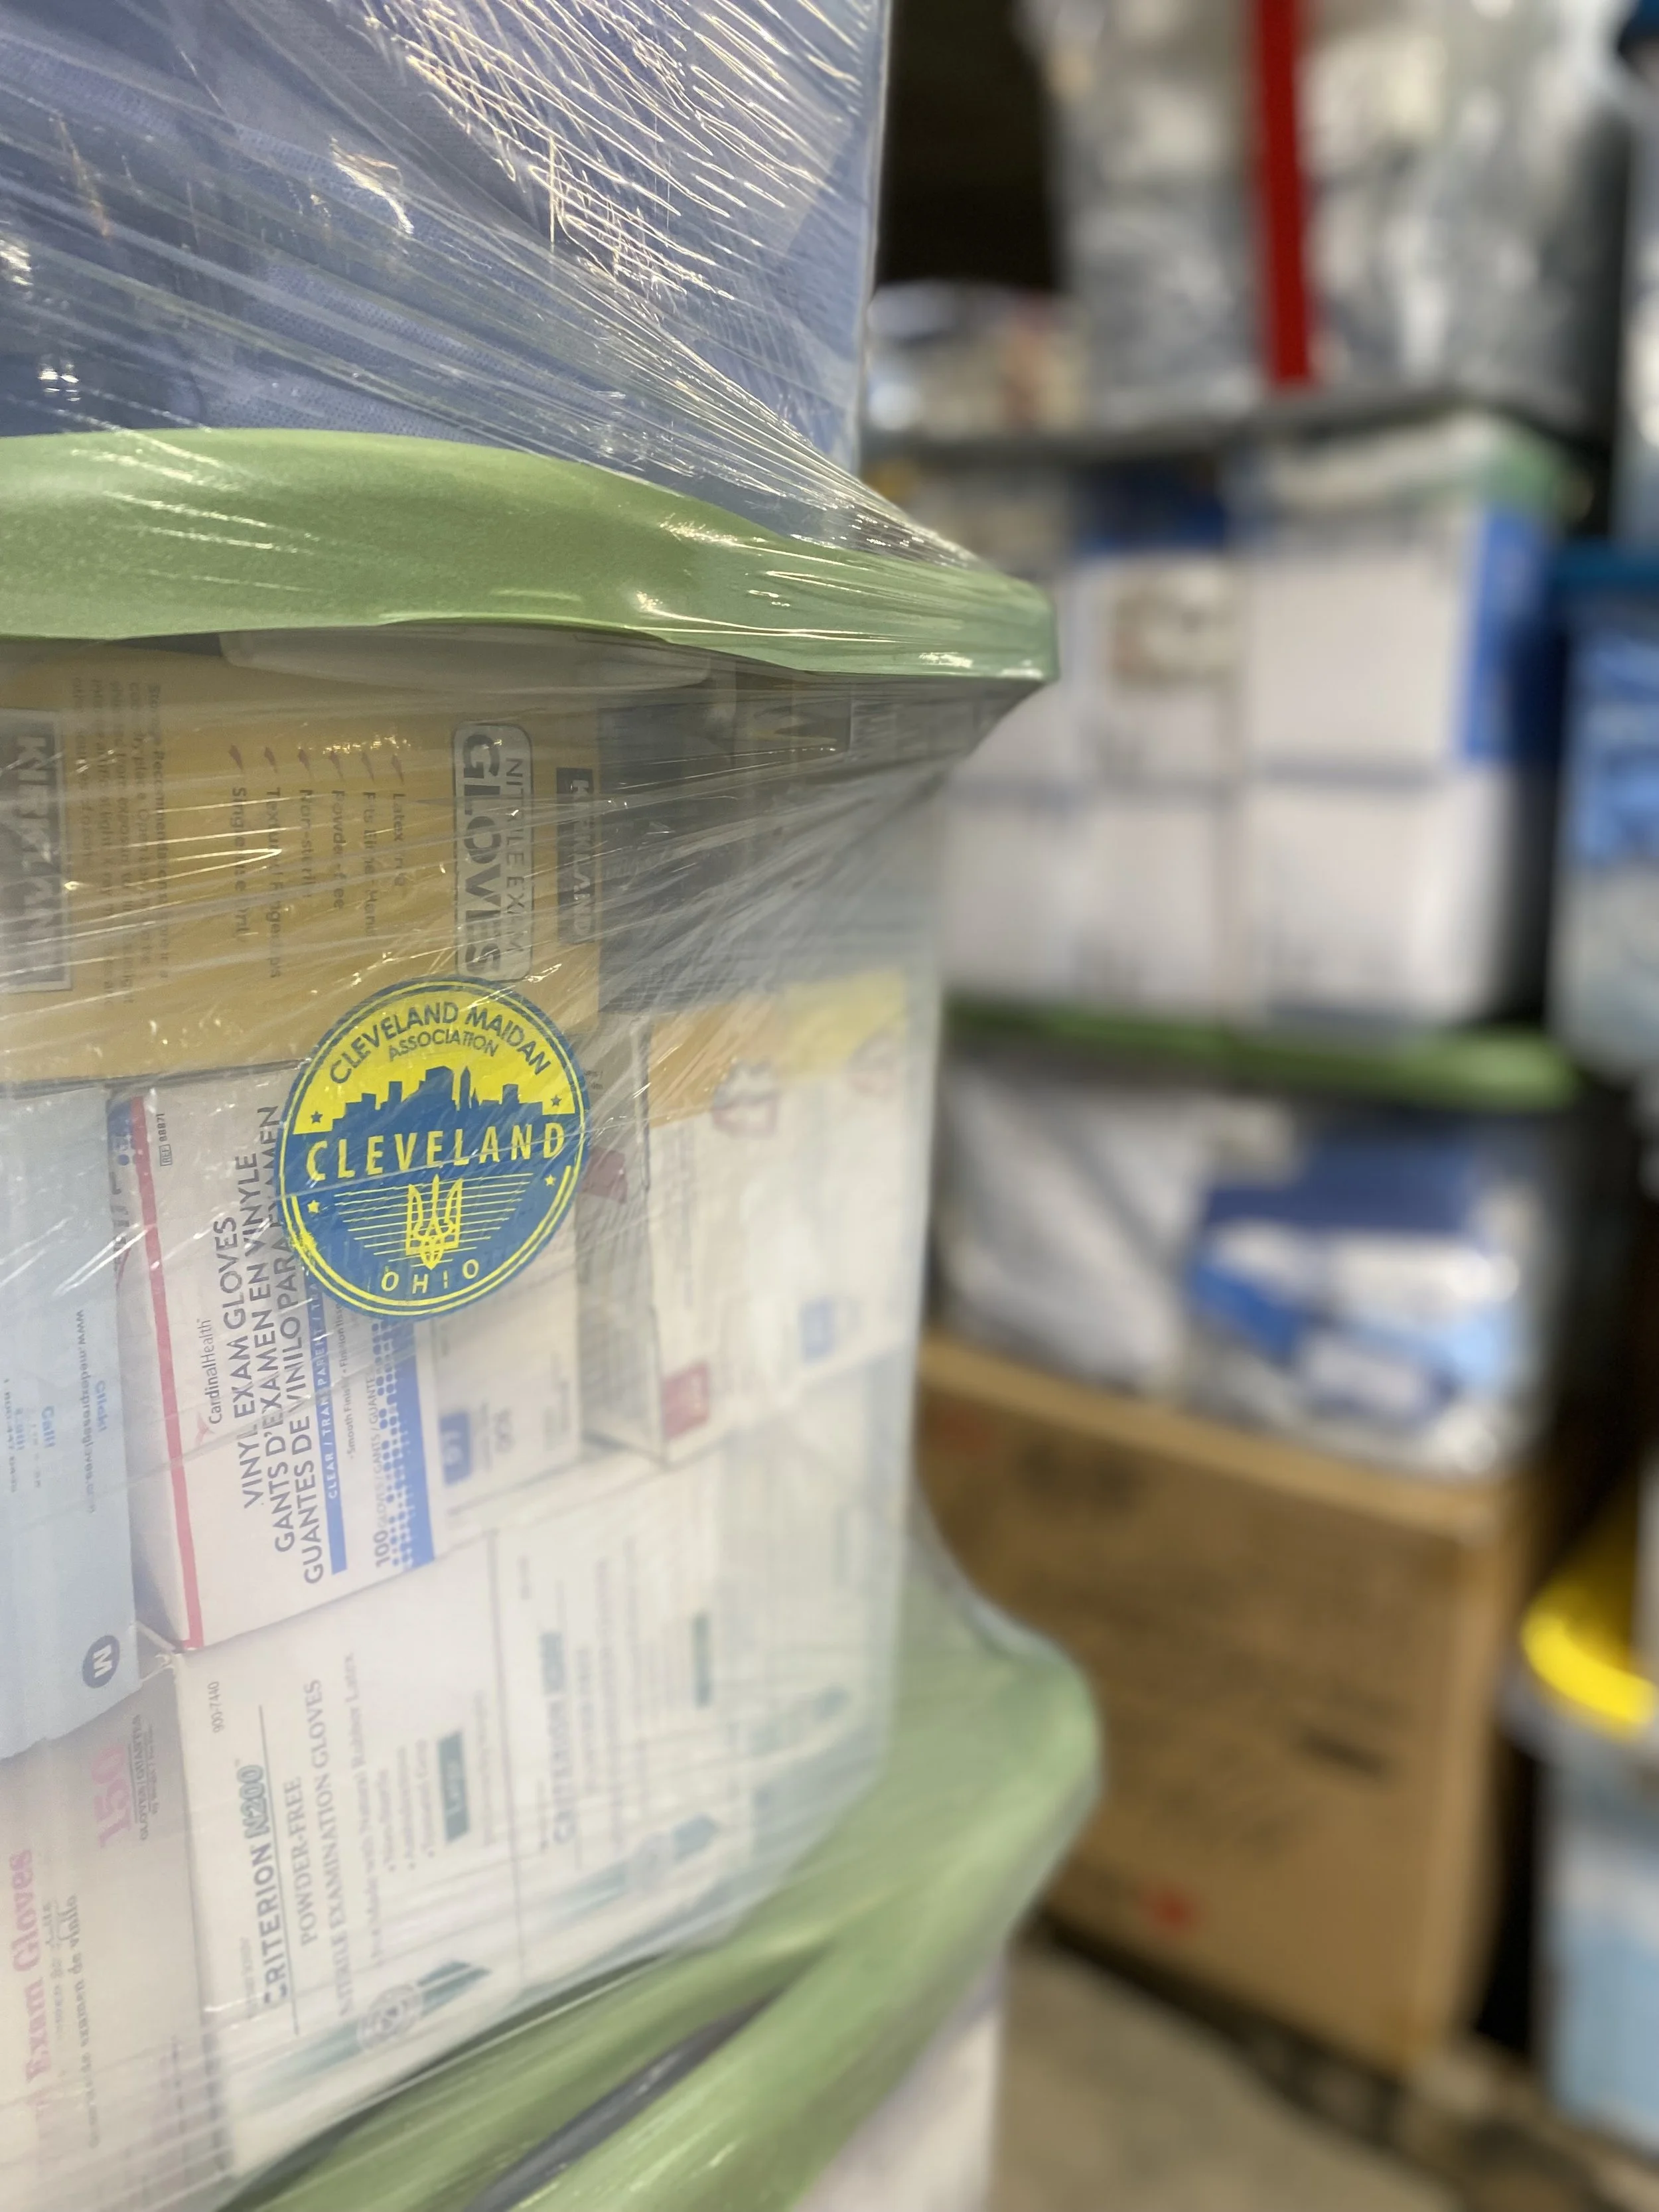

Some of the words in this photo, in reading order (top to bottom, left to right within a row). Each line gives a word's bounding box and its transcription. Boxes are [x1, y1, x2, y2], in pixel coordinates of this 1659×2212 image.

[17, 735, 54, 959] KIRKLAN
[115, 797, 131, 869] exposur
[265, 787, 282, 876] Texturd
[299, 789, 315, 899] Non-stril
[331, 790, 347, 909] Powde-fee
[392, 792, 407, 842] Latex
[464, 733, 502, 975] GLOVES
[506, 757, 524, 864] NITRILE
[394, 849, 407, 887] ree
[232, 899, 250, 942] nly
[506, 876, 525, 952] EXAM
[329, 1001, 459, 1085] CLEVELAND
[464, 1005, 552, 1076] MAIDAN
[388, 1029, 500, 1063] ASSOCIATION
[256, 1104, 283, 1229] EXMEN
[305, 1122, 565, 1183] CLEVELAND
[234, 1152, 267, 1257] VINYLE
[213, 1217, 246, 1331] GLOVES
[246, 1262, 271, 1301] EN
[271, 1236, 299, 1310] PARA
[380, 1258, 480, 1294] OHIO
[226, 1335, 255, 1419] EXAM
[250, 1309, 286, 1457] D'EXAMEN
[279, 1316, 307, 1414] VINILO
[313, 1328, 330, 1437] TRANPARENT
[342, 1385, 352, 1413] Finis
[364, 1371, 379, 1425] GUANTE
[76, 1309, 96, 1513] www.medexpressglves.cm
[289, 1415, 313, 1456] DE
[369, 1434, 381, 1472] GANTS
[236, 1424, 264, 1509] VINYL
[266, 1461, 295, 1553] GANTS
[325, 1452, 338, 1500] CLEAR
[293, 1460, 325, 1585] GUANTES
[372, 1530, 390, 1568] 100
[207, 1680, 225, 1733] 900-7440
[303, 1679, 330, 1769] GLOVES
[90, 1743, 131, 1849] 150
[236, 1764, 271, 1839] N200
[282, 1776, 319, 1947] POWDER-FREE
[314, 1772, 346, 1930] EXAMINATION
[8, 1848, 41, 1972] Gloves
[250, 1842, 288, 2004] CRITERION
[23, 1977, 51, 2083] Exam
